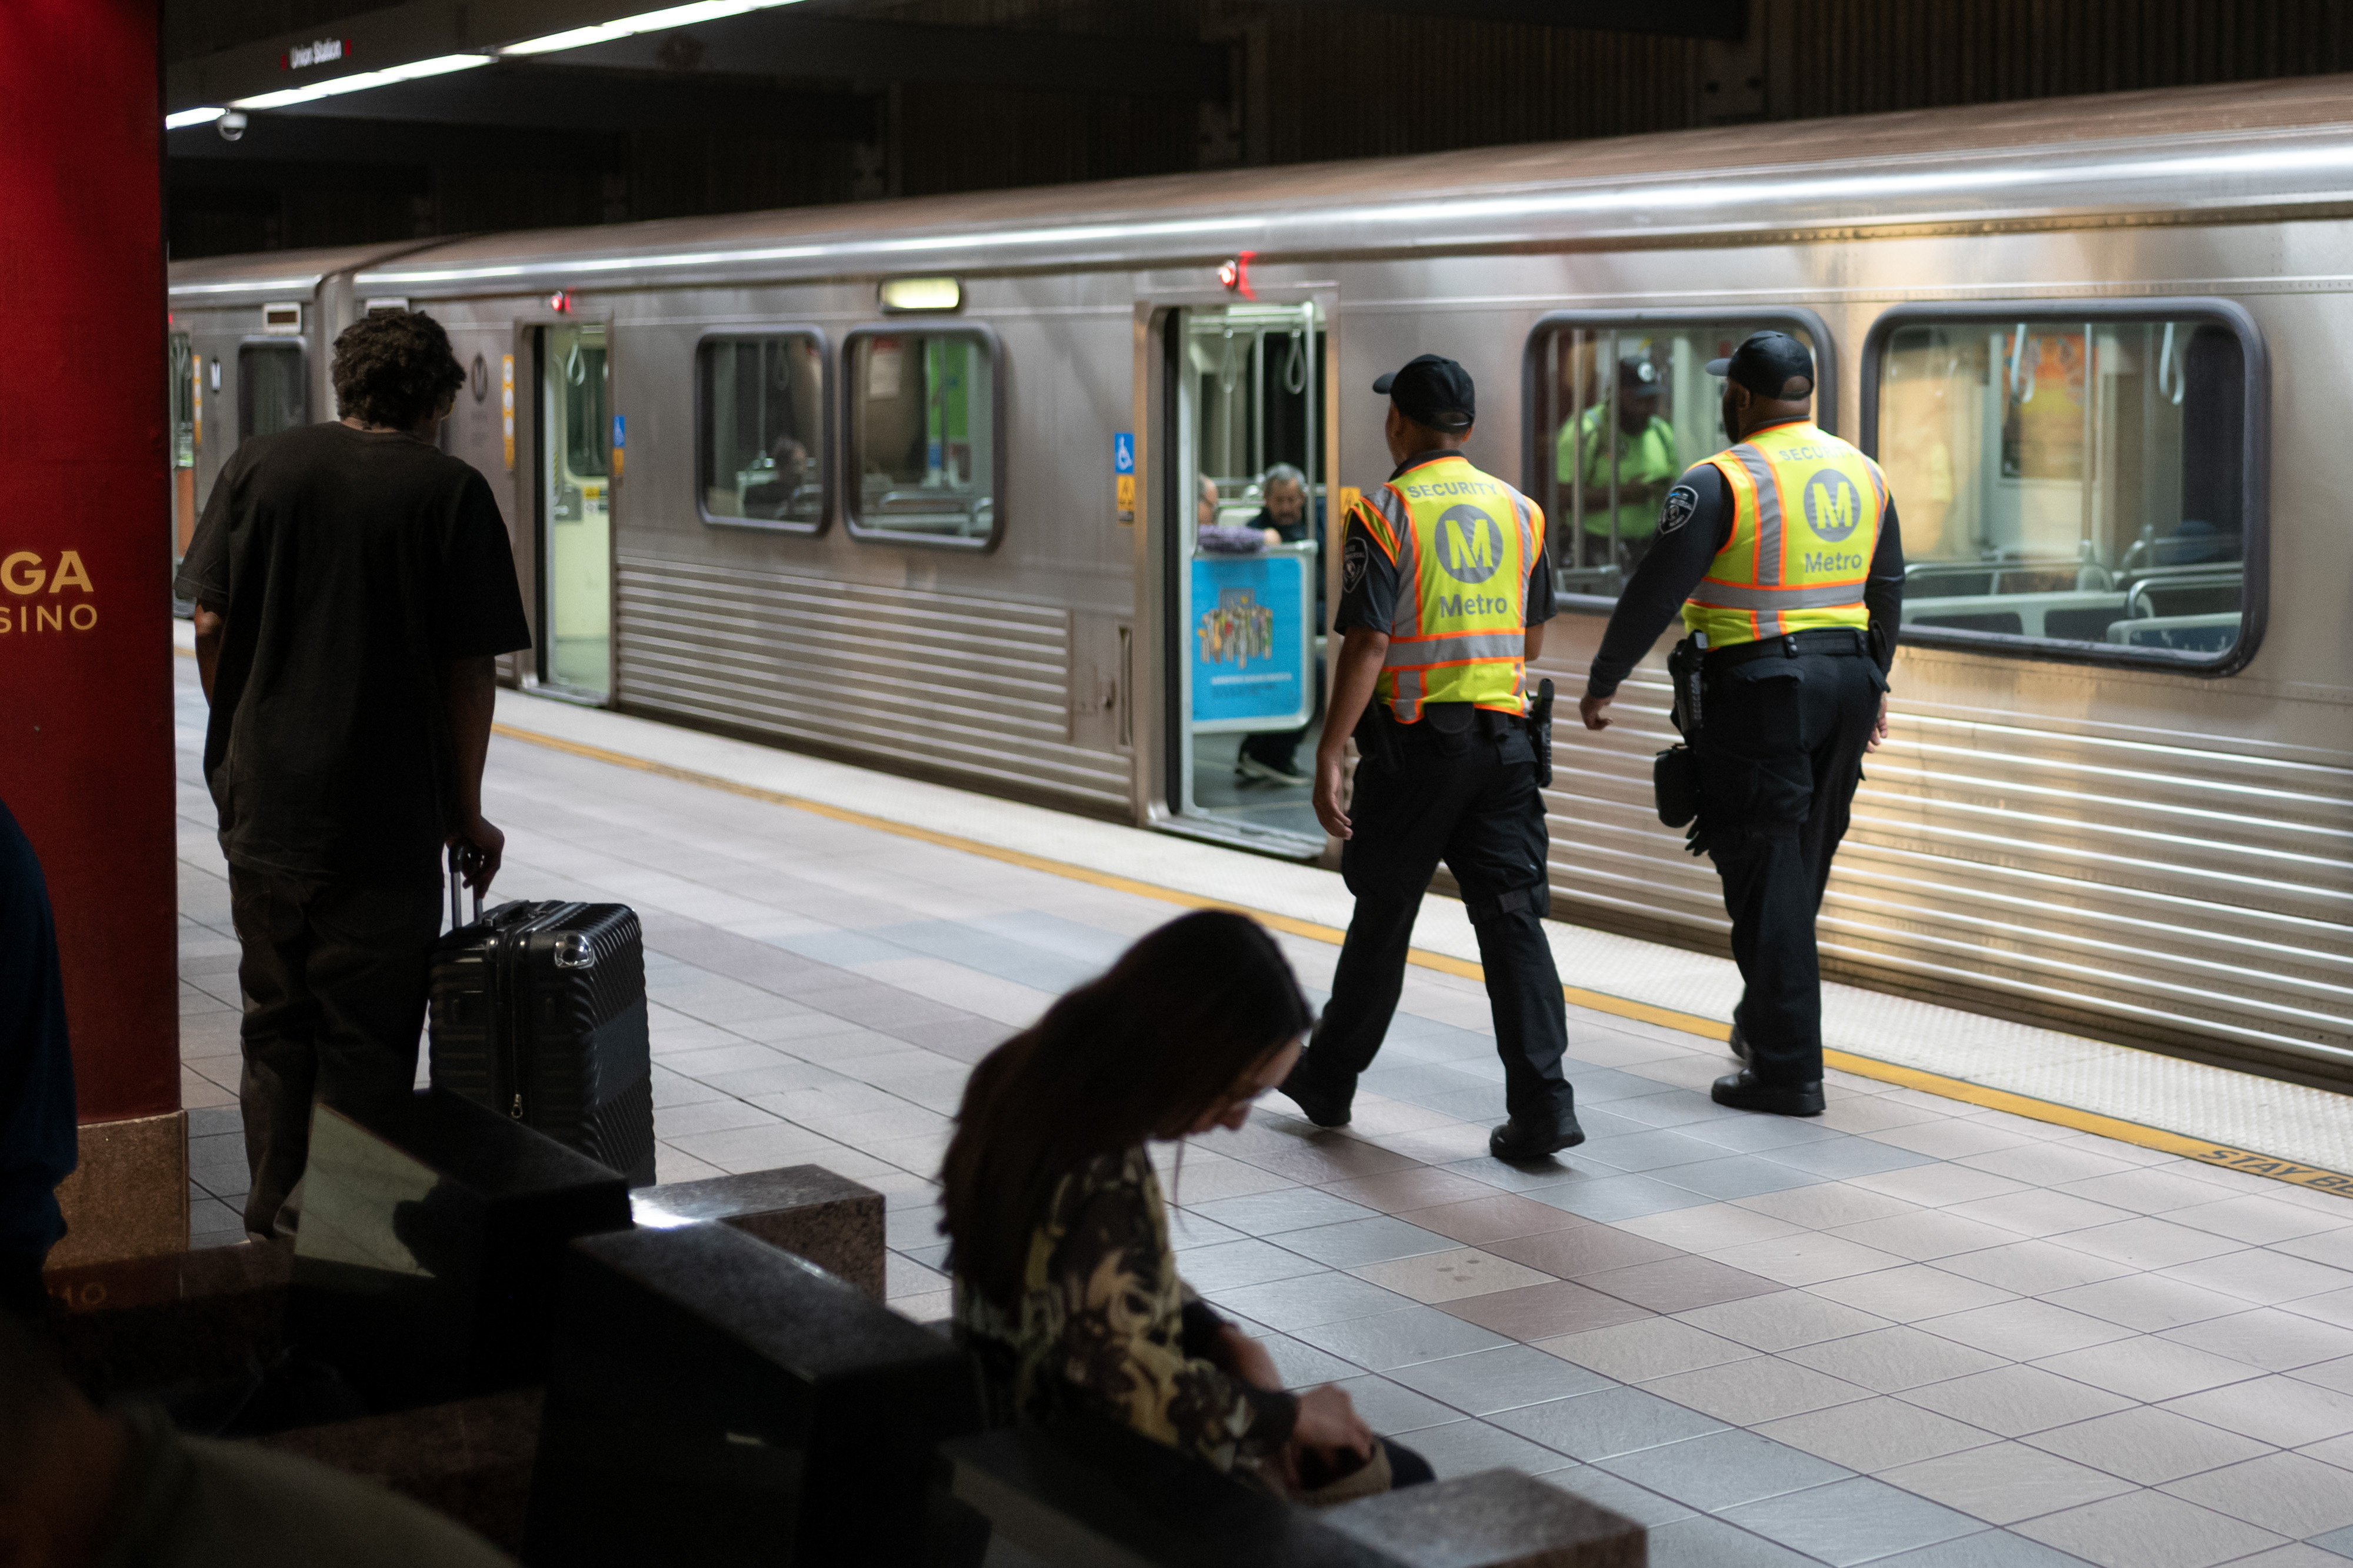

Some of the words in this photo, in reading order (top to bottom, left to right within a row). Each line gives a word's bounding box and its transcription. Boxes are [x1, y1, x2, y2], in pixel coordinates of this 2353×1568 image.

[290, 45, 313, 69] Union
[314, 37, 342, 64] Station
[1778, 445, 1854, 461] SECURITY
[1407, 481, 1498, 498] SECURITY
[1812, 481, 1853, 529] M
[1444, 518, 1494, 569] M
[1, 551, 94, 595] GA
[1804, 551, 1862, 573] Metro
[0, 603, 98, 633] SINO
[1439, 593, 1508, 618] Metro
[2199, 1150, 2314, 1176] STAY
